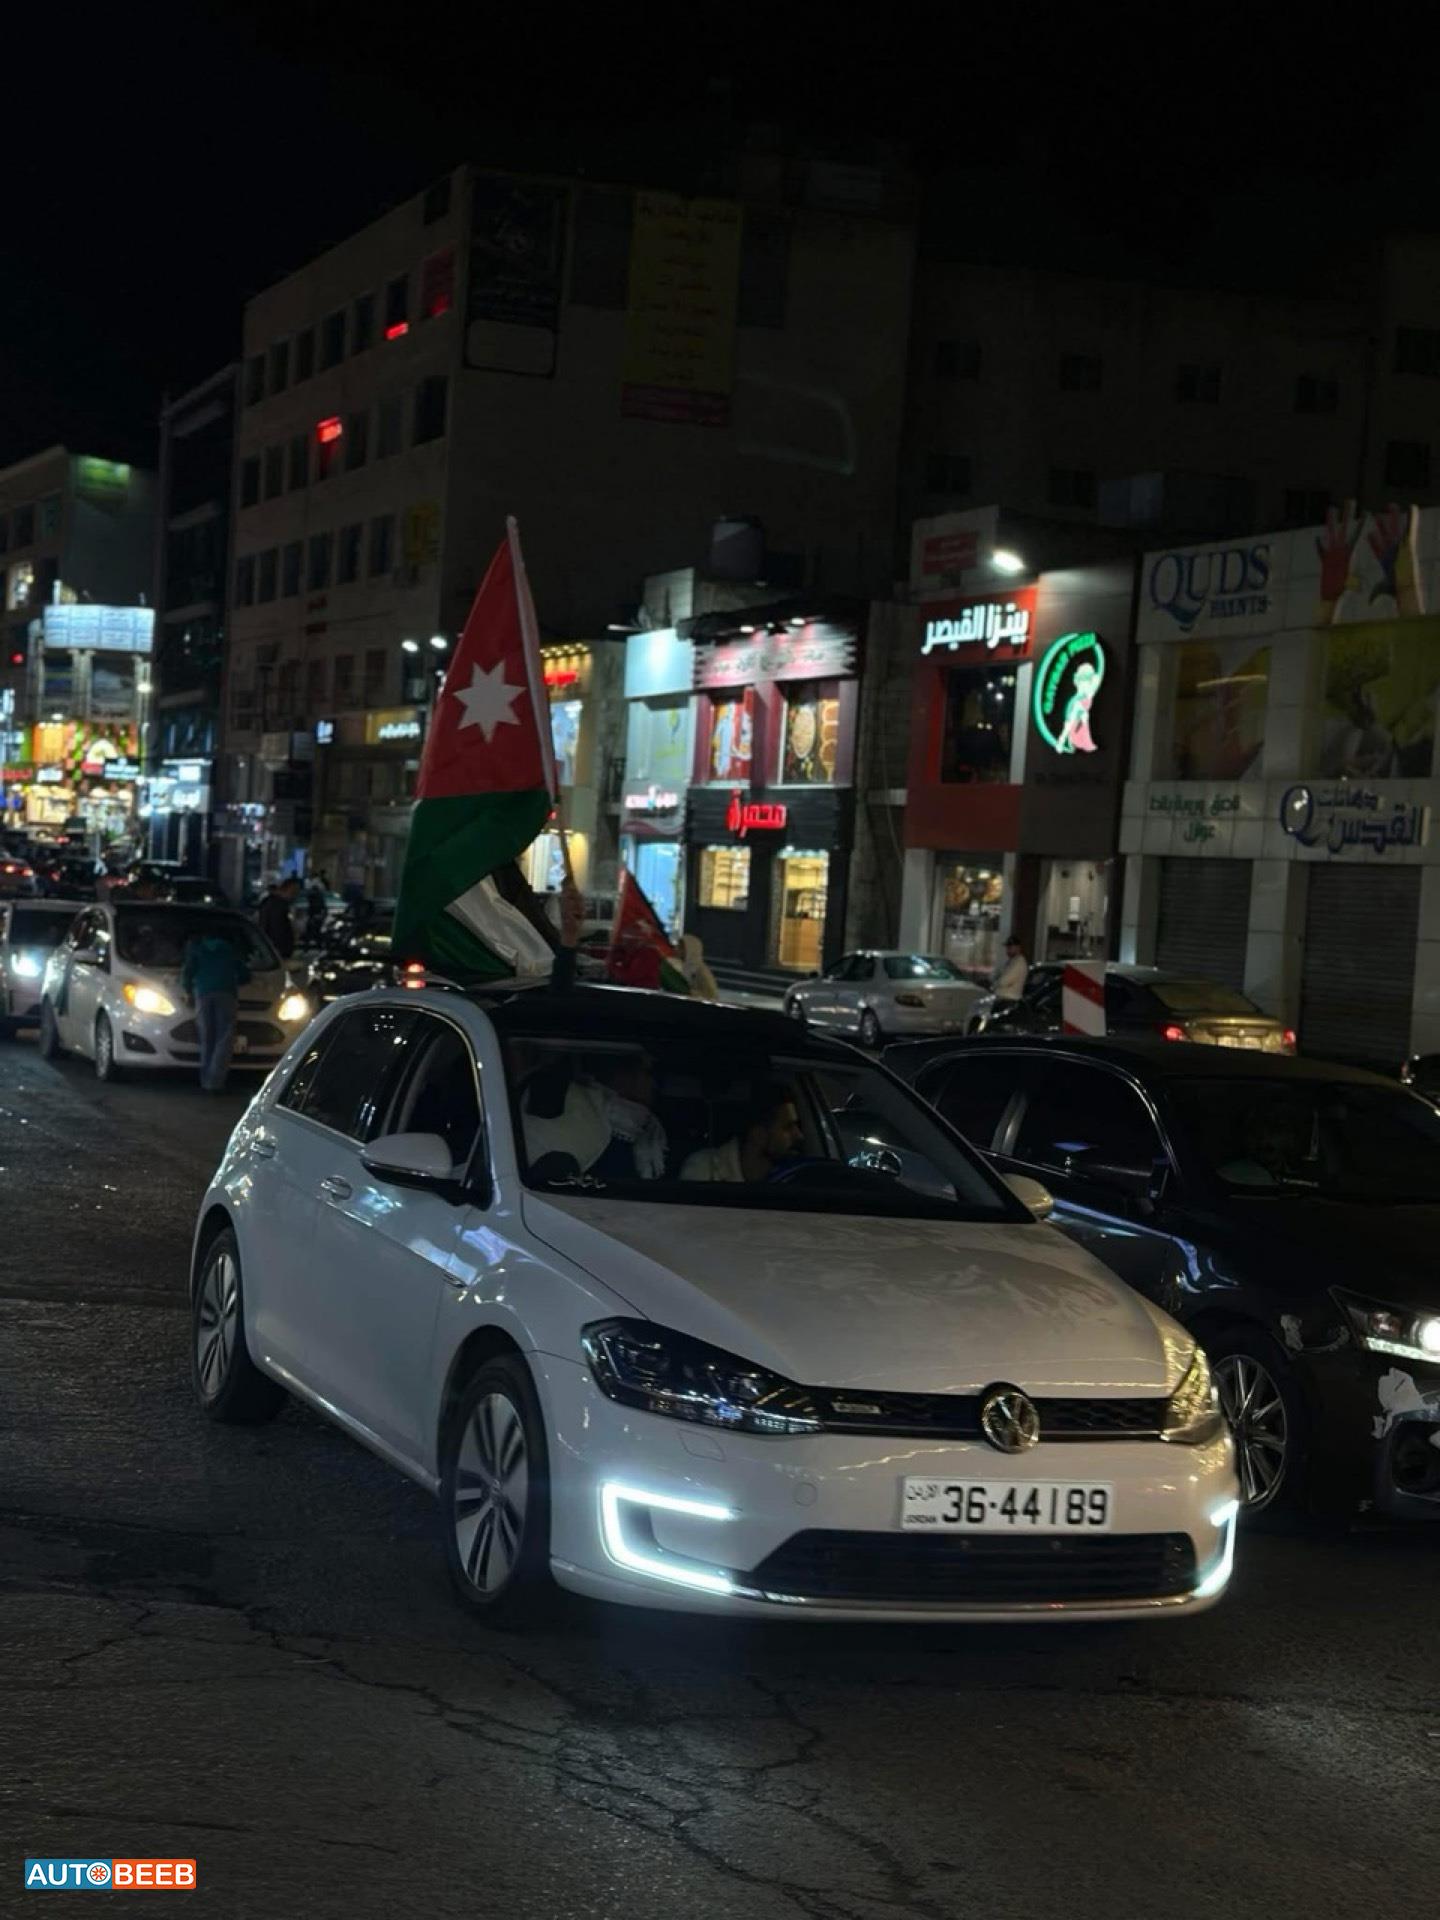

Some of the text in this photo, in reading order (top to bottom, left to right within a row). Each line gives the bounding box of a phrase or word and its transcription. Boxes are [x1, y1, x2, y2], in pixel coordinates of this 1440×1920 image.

[1150, 546, 1270, 626] QUDS
[1210, 595, 1268, 618] PAINTS
[921, 602, 1029, 655] بيتزا القيصر
[1328, 802, 1423, 853] القدس
[942, 1484, 1109, 1526] 36-44189
